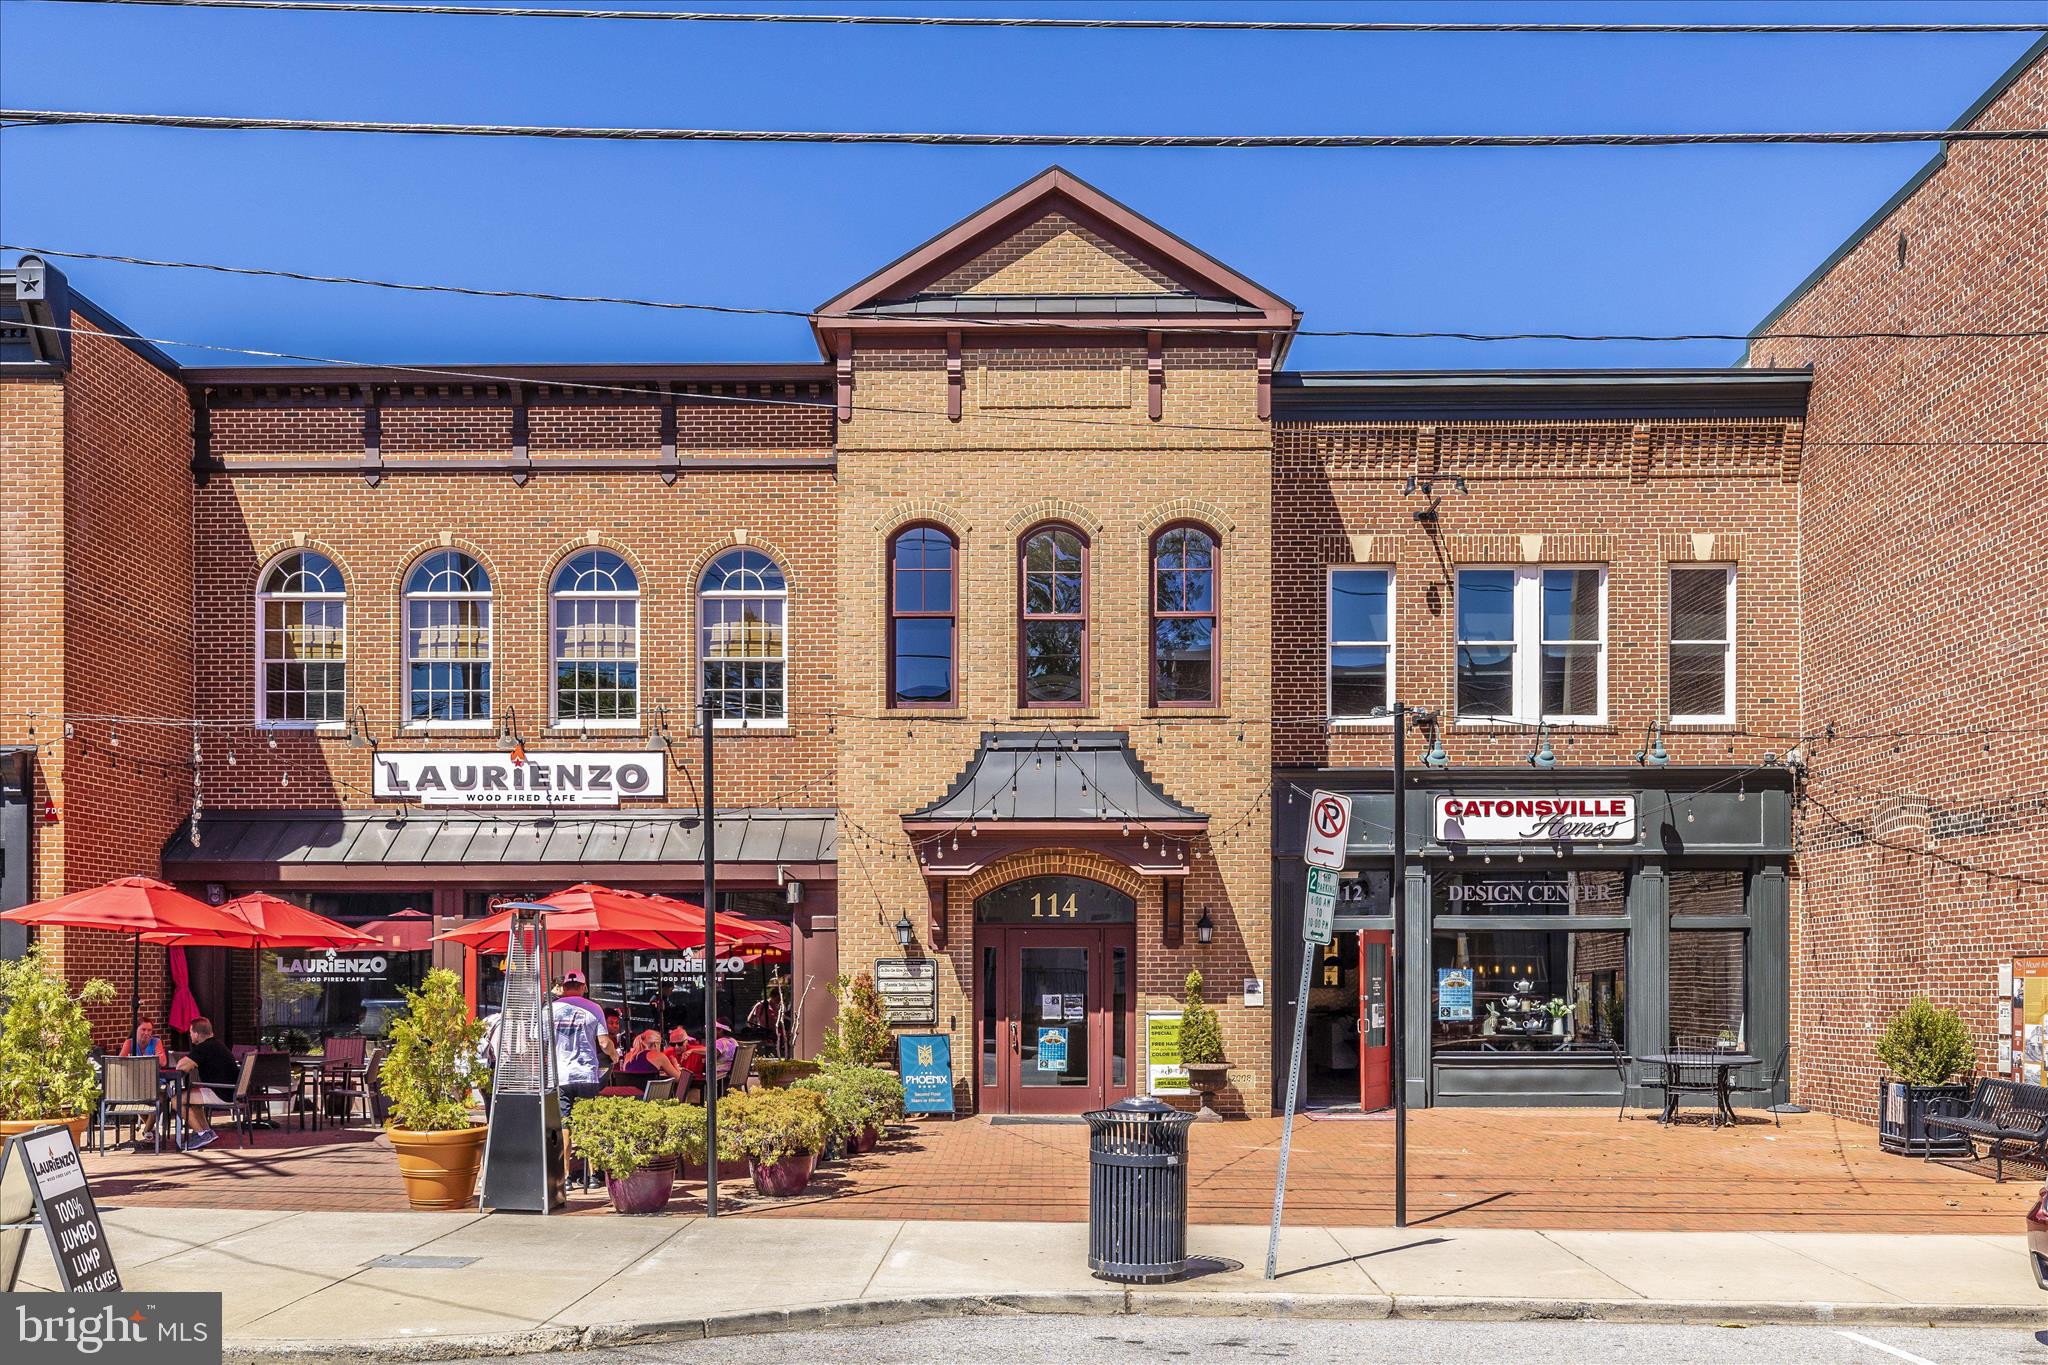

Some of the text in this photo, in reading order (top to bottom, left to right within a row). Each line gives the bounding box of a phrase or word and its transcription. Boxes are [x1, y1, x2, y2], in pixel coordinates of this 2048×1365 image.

[466, 794, 576, 802] WOOD FIRED CAFE
[45, 807, 63, 815] FDC
[1444, 800, 1627, 817] CATONSVILLE
[1518, 812, 1620, 838] Homes
[1309, 871, 1318, 889] 2
[1316, 882, 1336, 895] PARKING
[1449, 885, 1611, 901] DESIGN CENTER
[1030, 892, 1078, 918] 114
[1323, 897, 1331, 908] AM
[1316, 907, 1323, 918] TO
[905, 1075, 948, 1084] PHOENIX
[55, 1196, 85, 1224] 100%
[60, 1220, 97, 1253] JUMBO
[72, 1247, 101, 1278] LUMP
[94, 1268, 118, 1292] CAKES
